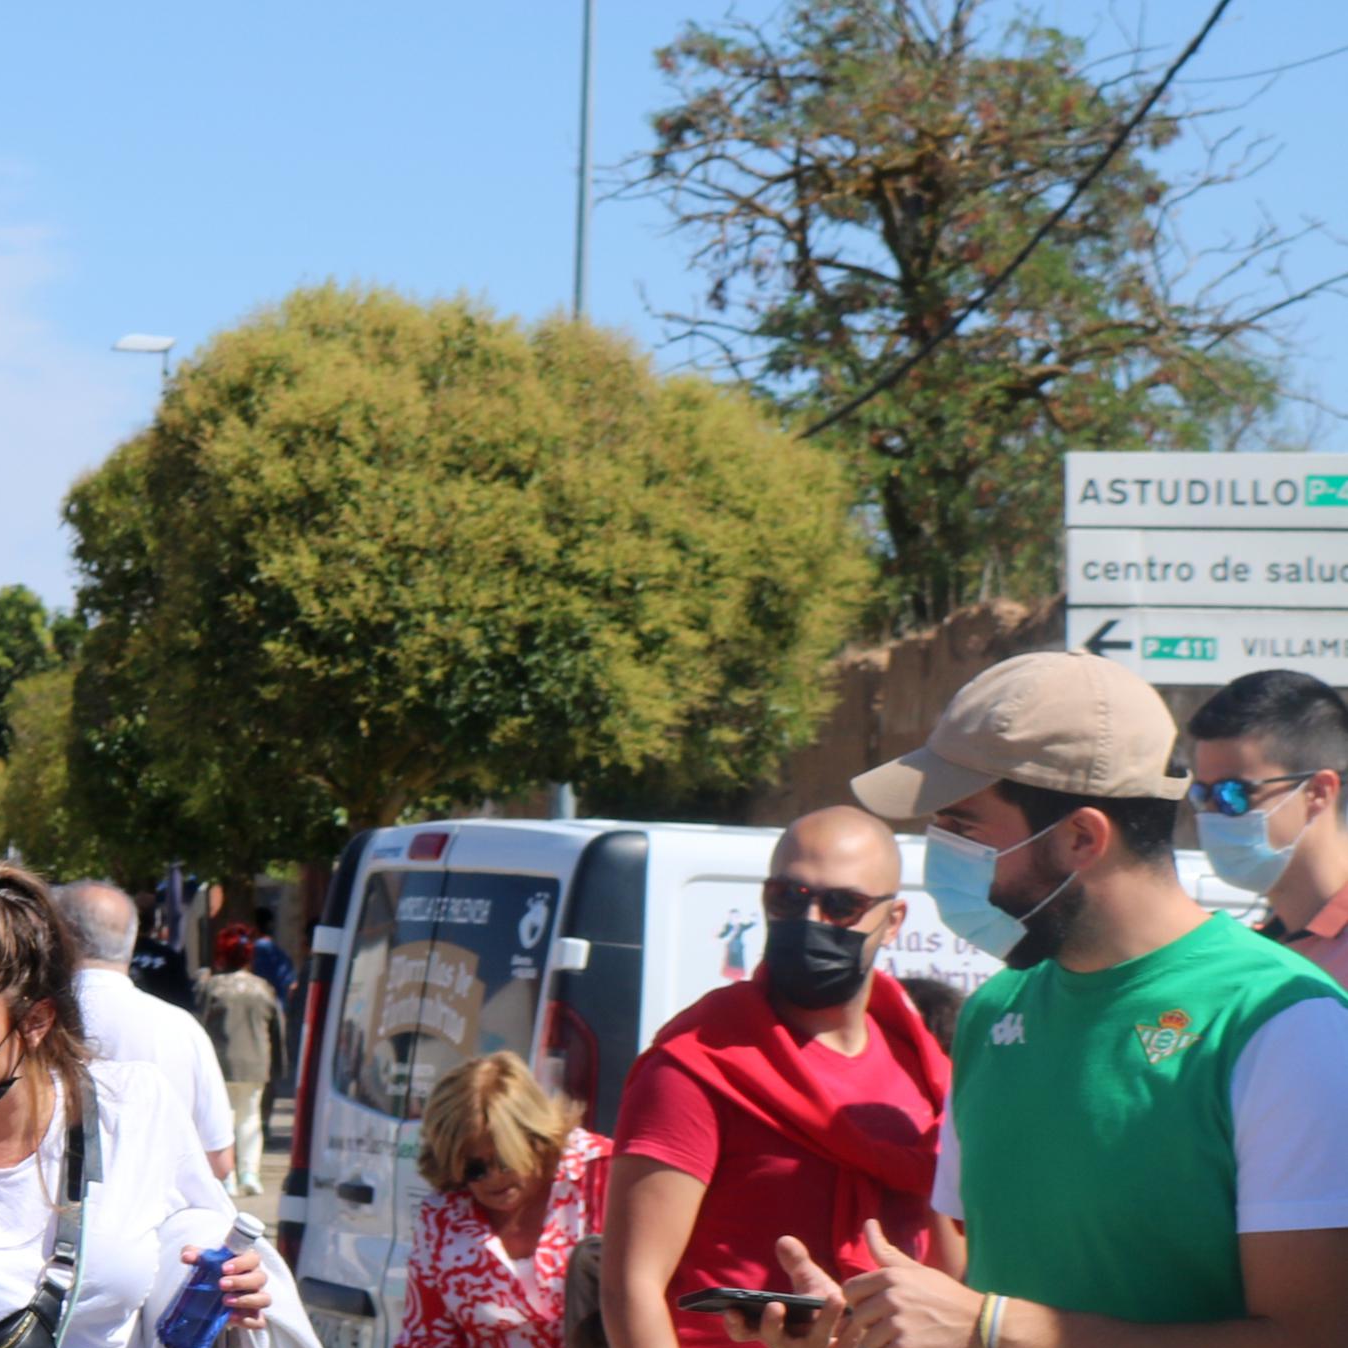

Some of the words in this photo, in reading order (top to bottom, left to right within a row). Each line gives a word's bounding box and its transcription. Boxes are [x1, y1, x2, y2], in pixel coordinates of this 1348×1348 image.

[1079, 478, 1299, 506] ASTUDILLO
[1081, 556, 1195, 583] centro
[1209, 555, 1251, 583] de
[1143, 638, 1216, 658] P-411
[1242, 638, 1348, 657] VILLAM
